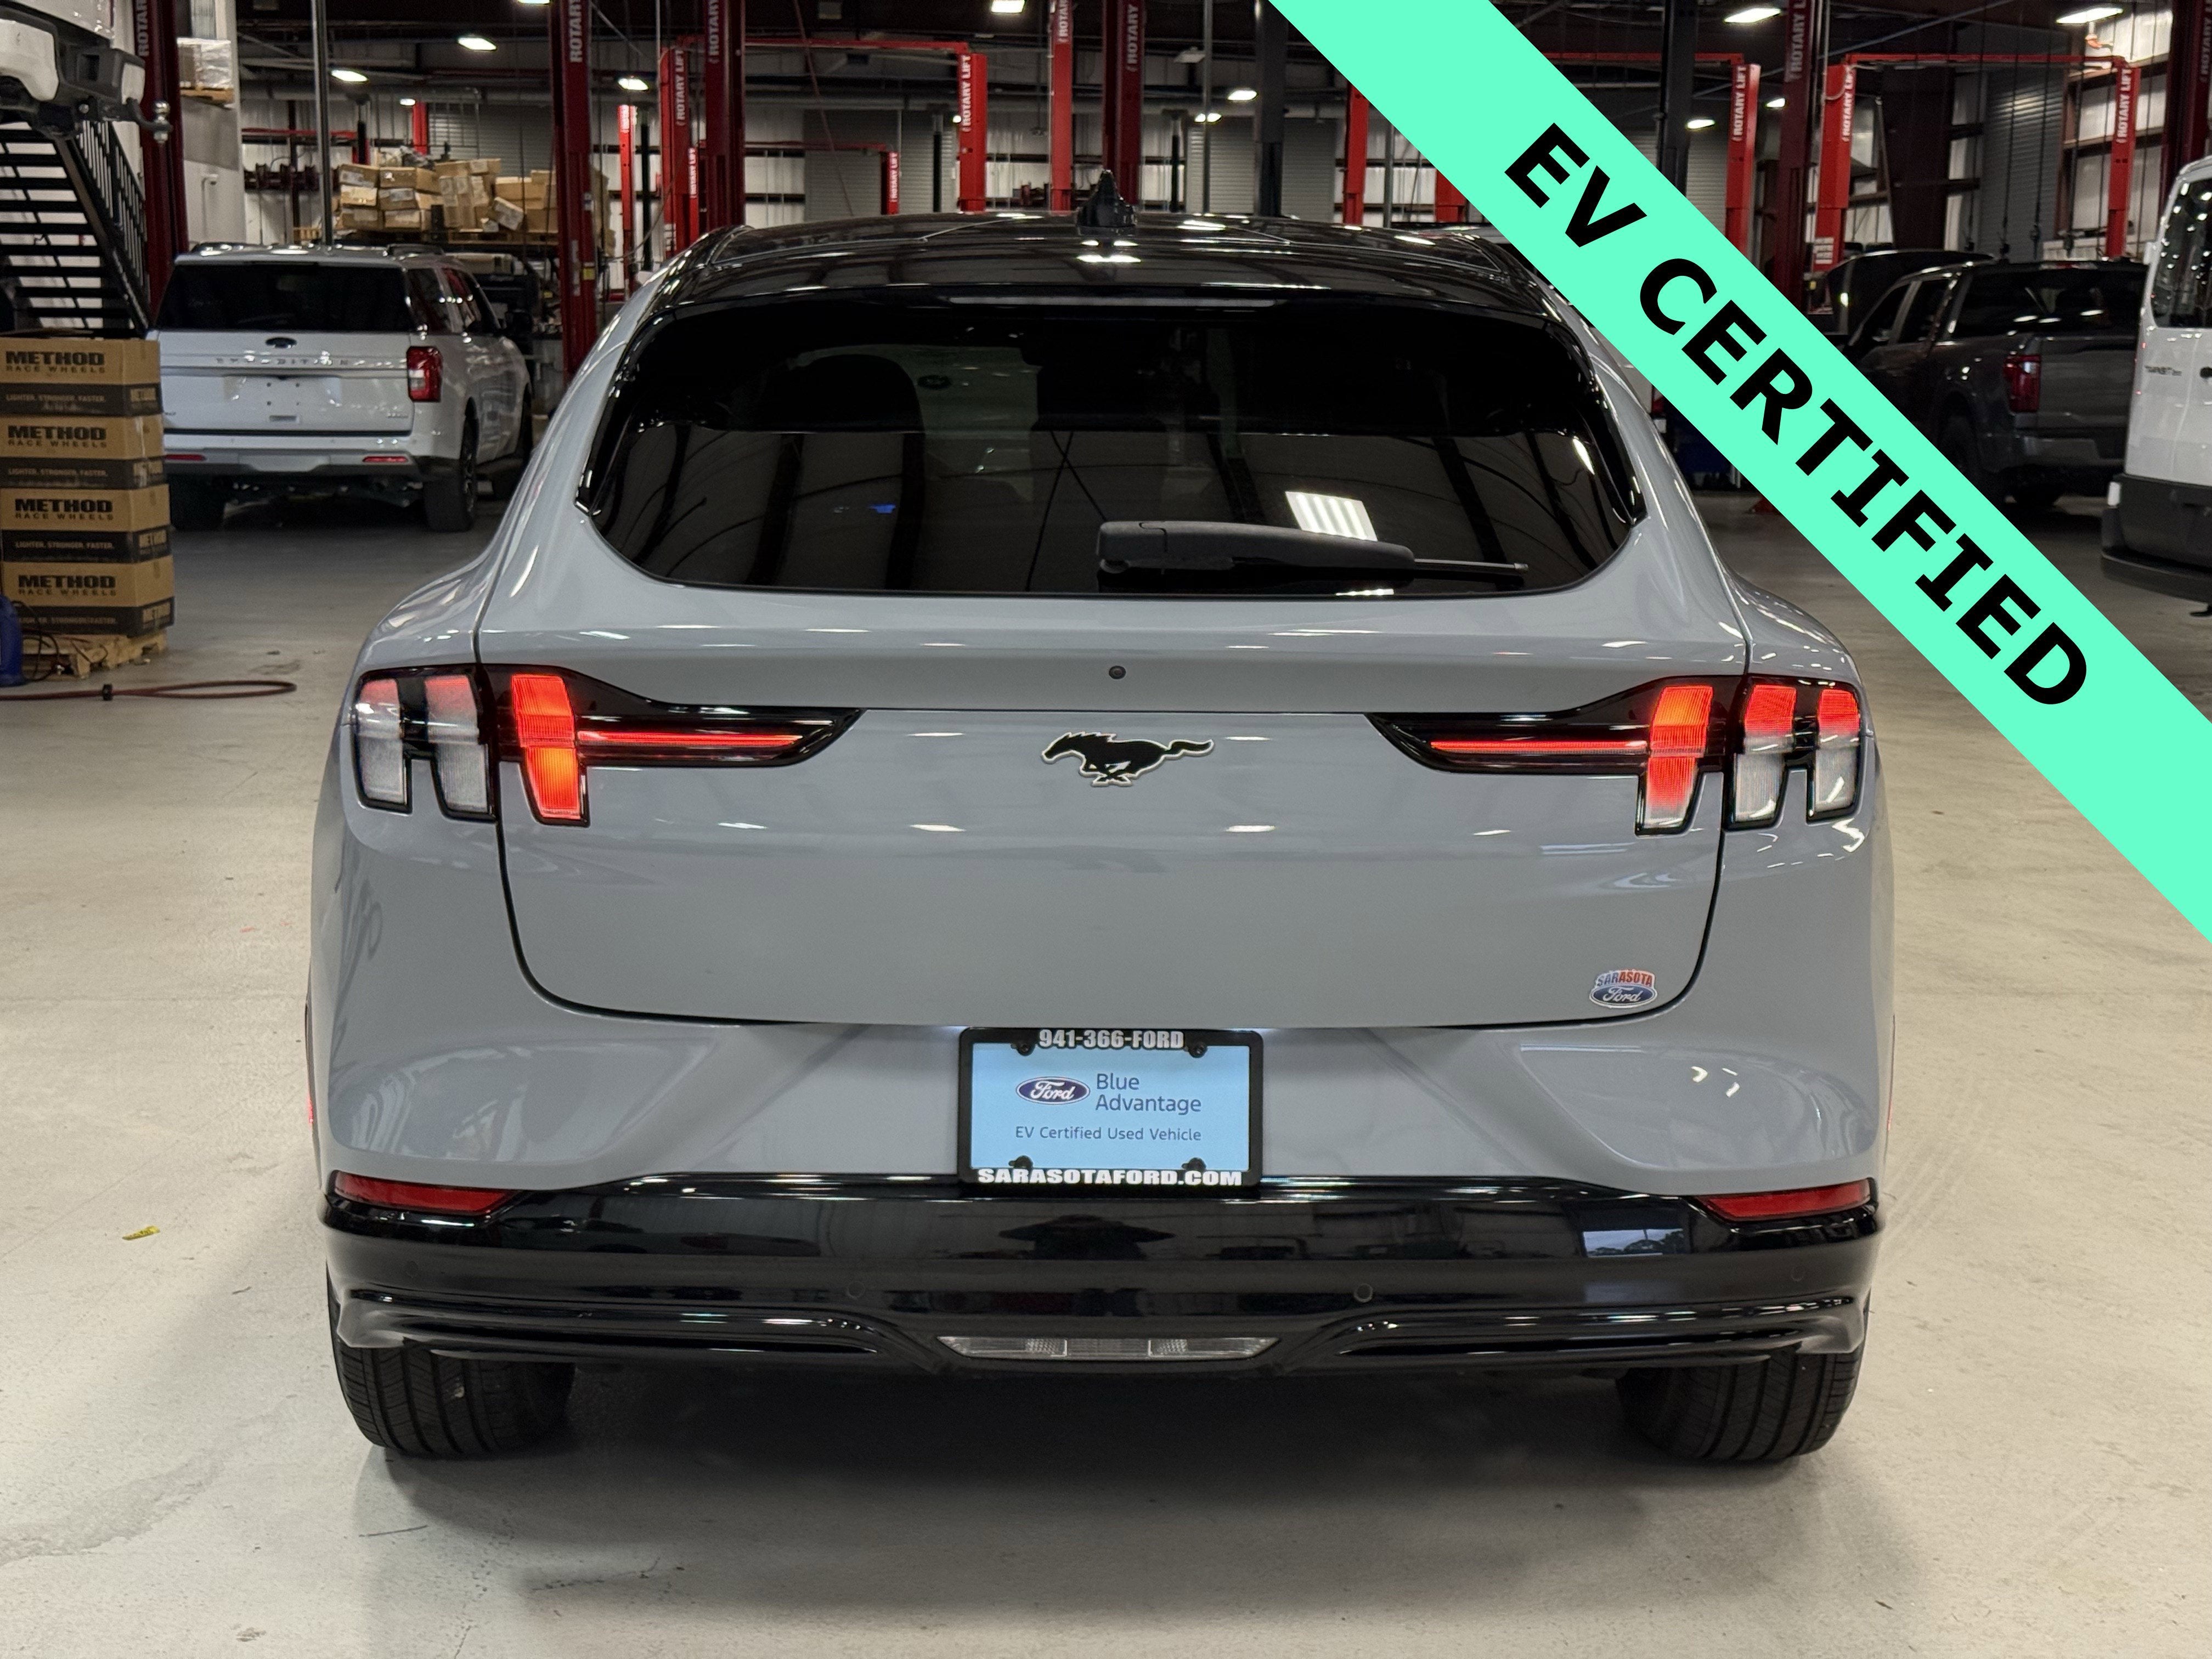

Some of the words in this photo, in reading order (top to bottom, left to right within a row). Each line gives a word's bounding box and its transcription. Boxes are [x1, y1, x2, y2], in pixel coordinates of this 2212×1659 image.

[1127, 4, 1139, 64] ROTARY
[1791, 14, 1805, 71] ROTARY
[675, 49, 684, 72] LIFT
[961, 55, 970, 78] LIFT
[1736, 66, 1746, 89] LIFT
[2120, 69, 2132, 91] LIFT
[675, 75, 685, 120] ROTARY
[962, 81, 971, 126] ROTARY
[1734, 92, 1745, 136] ROTARY
[1842, 92, 1852, 136] ROTARY
[2117, 94, 2130, 138] ROTARY
[6, 351, 104, 365] METHOD
[8, 426, 106, 440] METHOD
[15, 499, 113, 512] METHOD
[18, 574, 116, 588] METHOD
[1596, 972, 1652, 988] SARASOTA
[1602, 986, 1644, 1002] Ford
[1039, 1029, 1183, 1049] 941-366-FORD
[1030, 1080, 1076, 1100] Ford
[1096, 1073, 1140, 1091] Blue
[1095, 1094, 1201, 1115] Advantage
[1015, 1126, 1035, 1138] EV
[1040, 1126, 1102, 1139] Certified
[1108, 1127, 1144, 1140] Used
[1149, 1127, 1201, 1141] Vehicle
[978, 1169, 1242, 1186] SARASOTAFORD.COM
